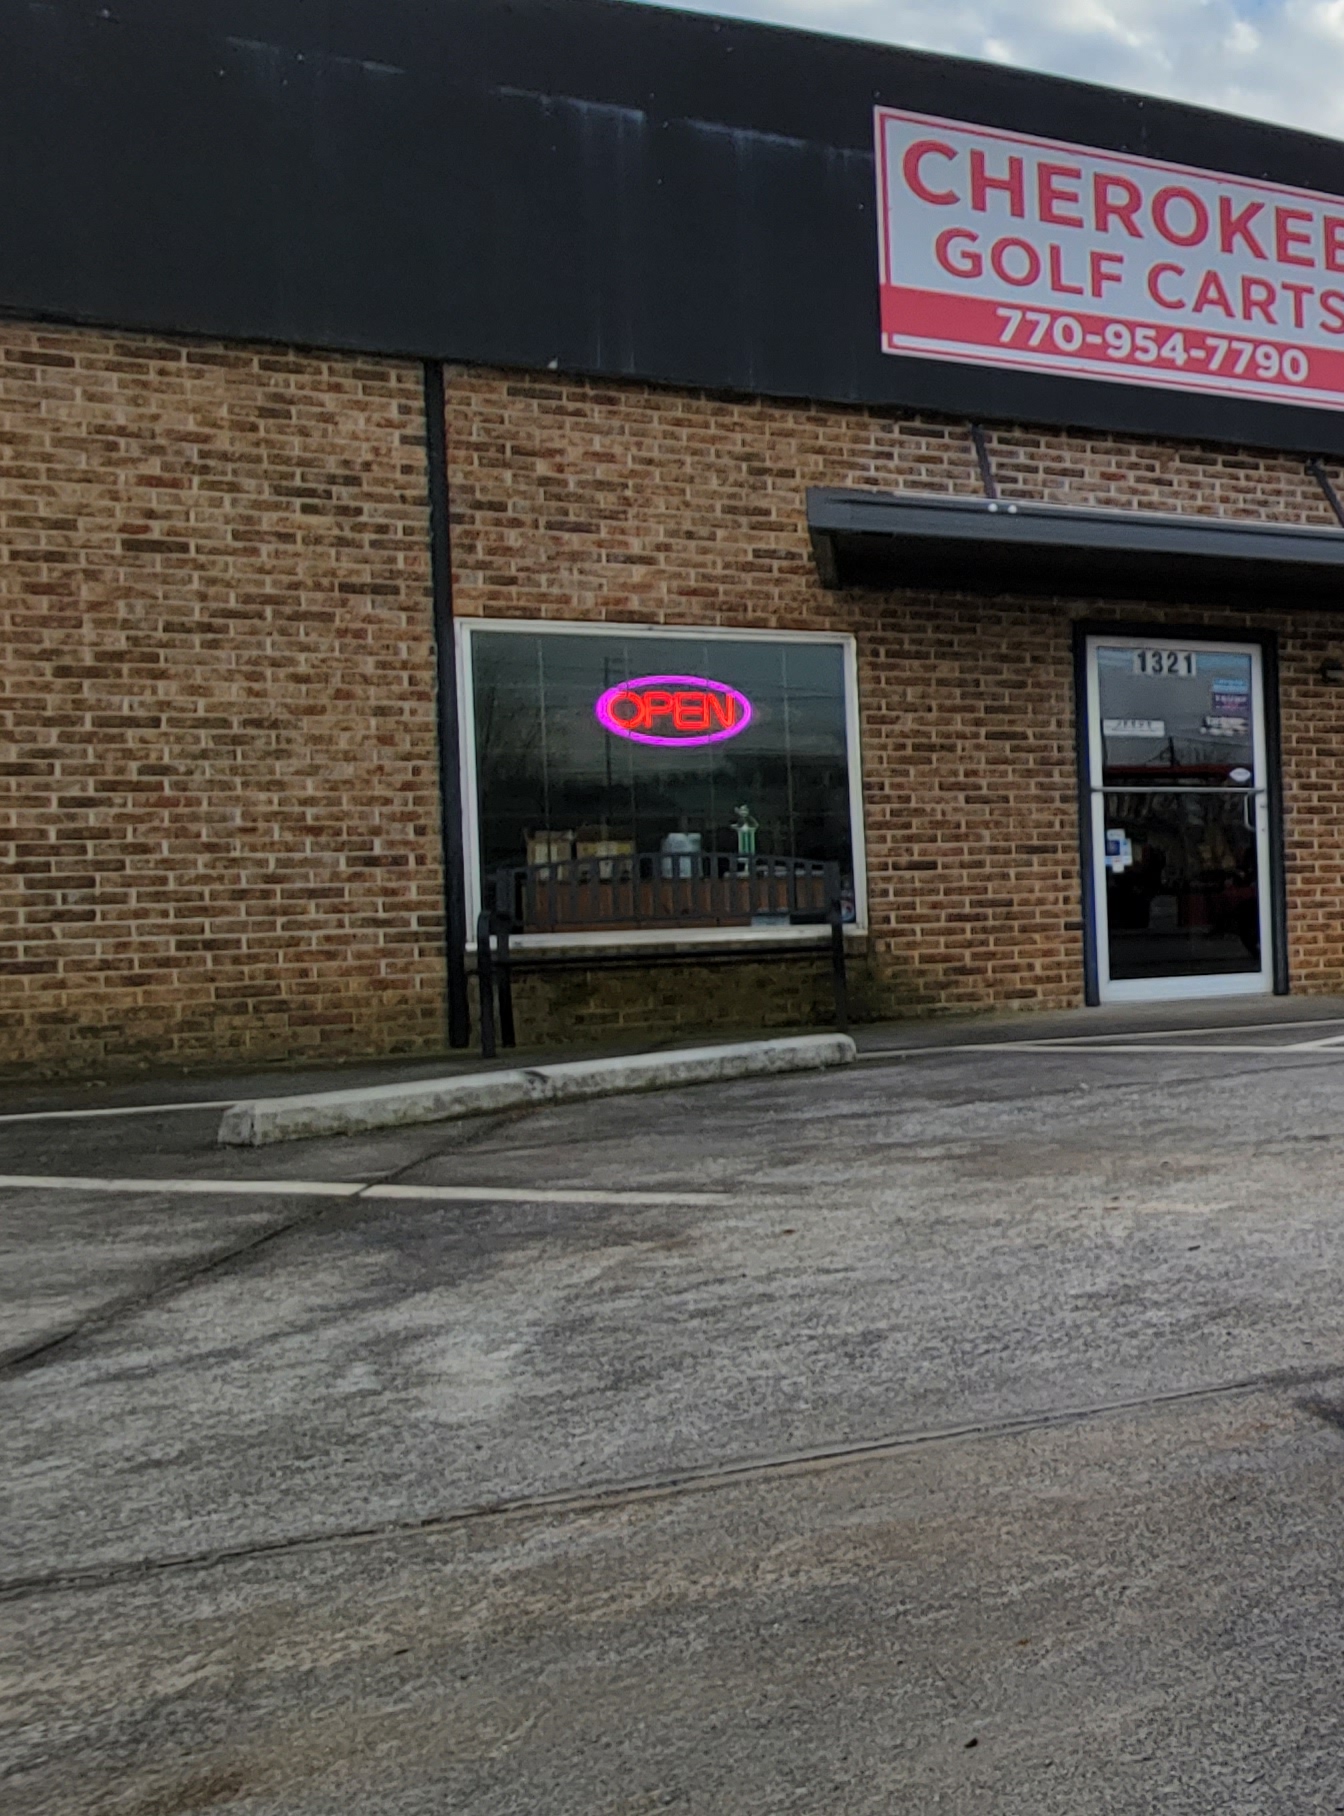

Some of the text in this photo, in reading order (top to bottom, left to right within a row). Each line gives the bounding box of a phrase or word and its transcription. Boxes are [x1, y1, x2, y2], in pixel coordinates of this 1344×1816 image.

[935, 228, 1124, 297] GOLF
[996, 307, 1308, 381] 770-954-7790
[1137, 650, 1193, 674] 1321
[606, 691, 736, 731] OPEN
